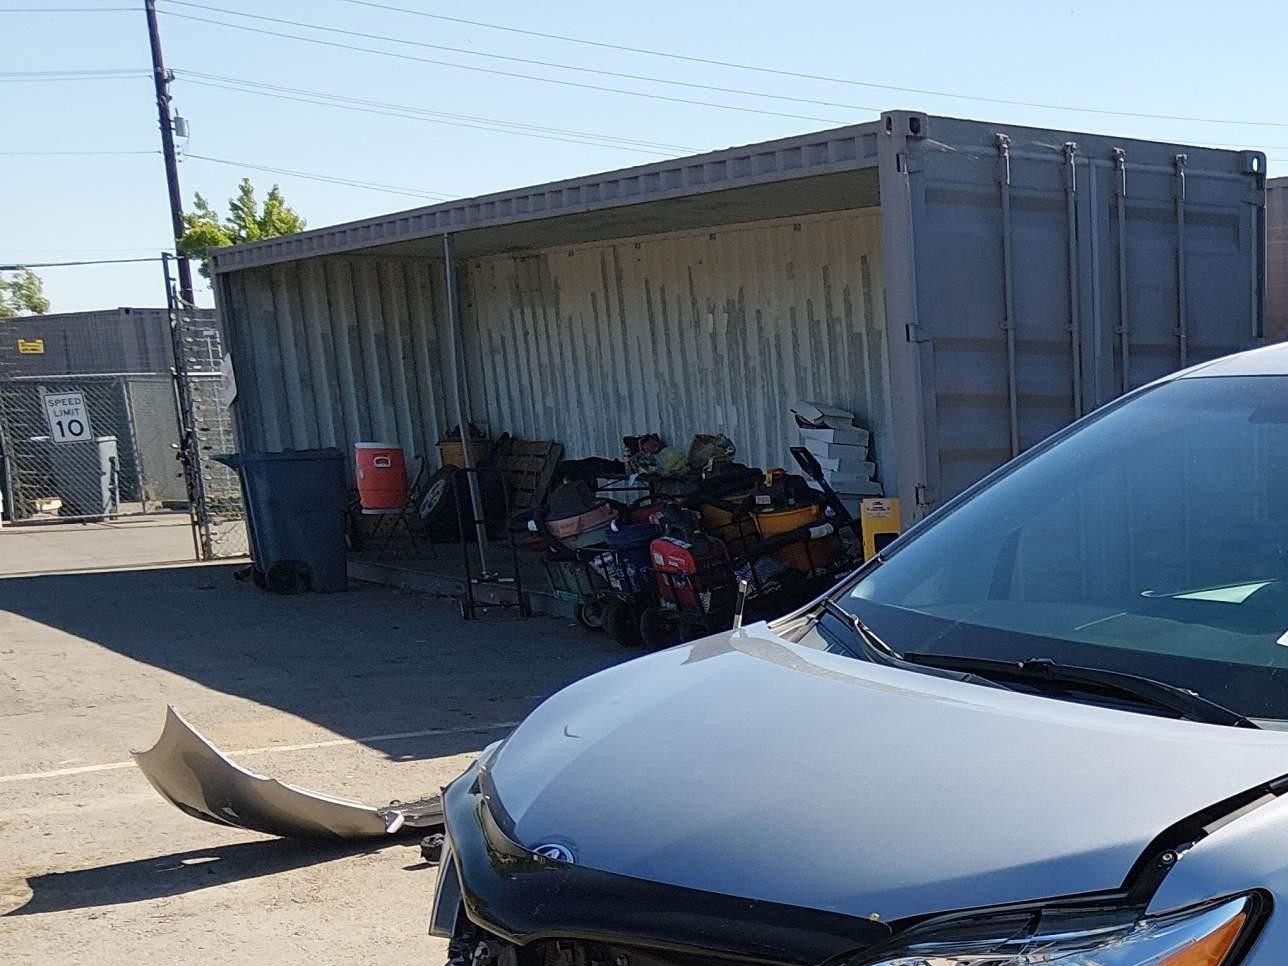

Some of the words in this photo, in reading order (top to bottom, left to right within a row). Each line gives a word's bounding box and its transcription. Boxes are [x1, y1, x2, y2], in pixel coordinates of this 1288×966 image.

[48, 398, 81, 407] SPEED
[53, 408, 80, 417] LIMIT
[56, 419, 84, 438] 10
